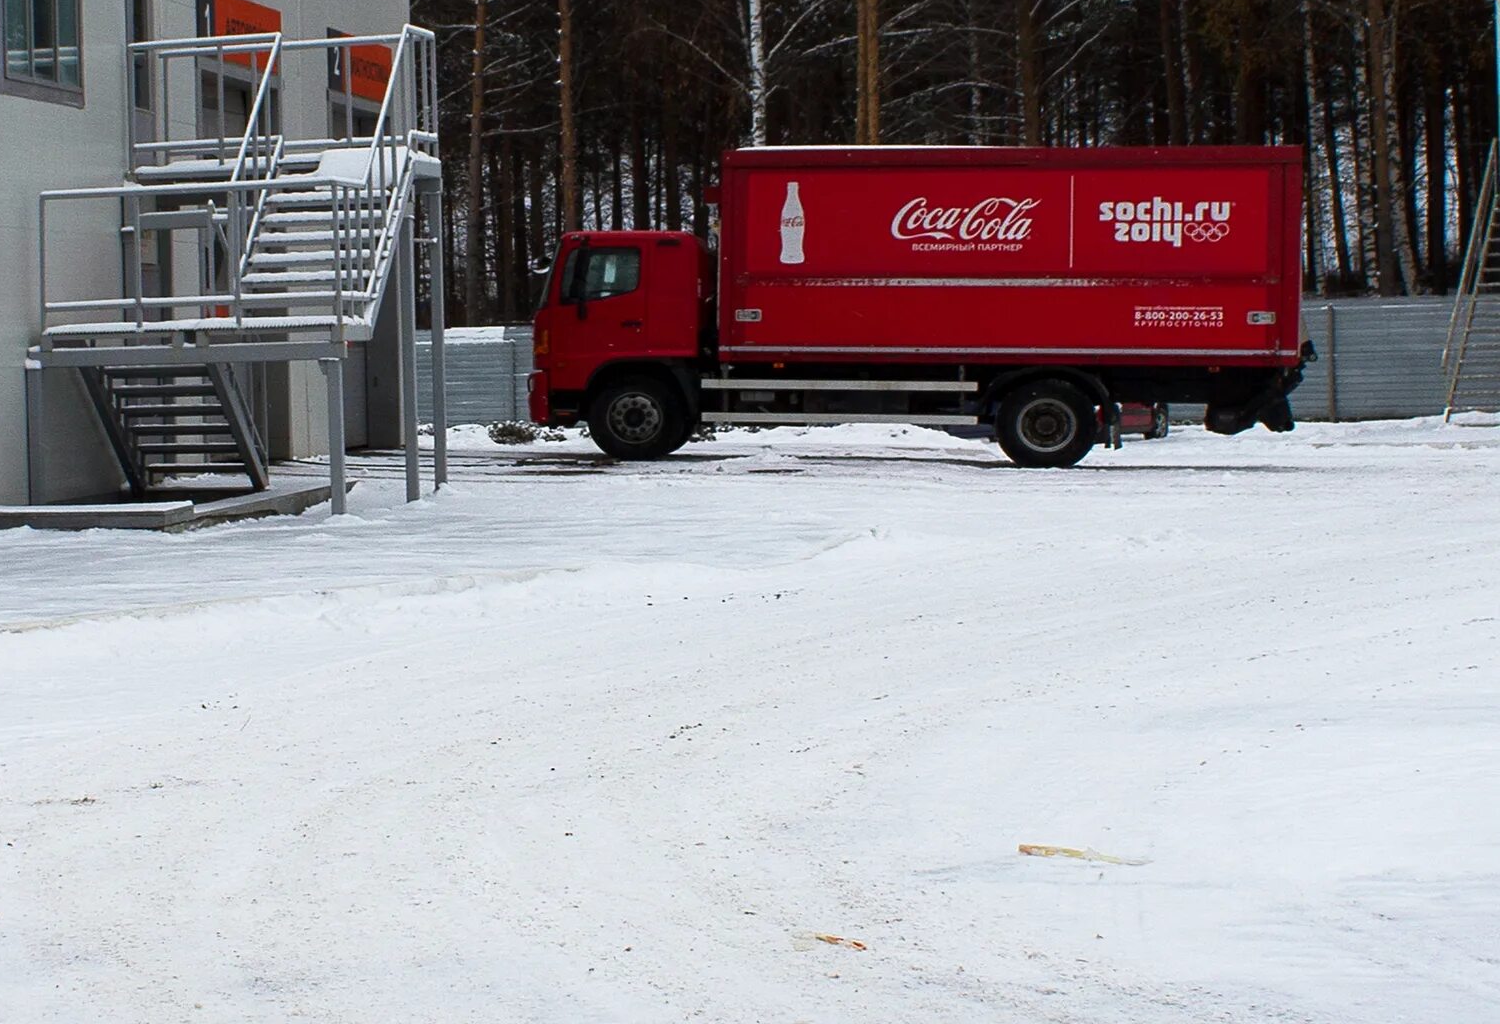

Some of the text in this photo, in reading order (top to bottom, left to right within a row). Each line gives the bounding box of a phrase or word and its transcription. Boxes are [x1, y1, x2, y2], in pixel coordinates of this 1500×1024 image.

[891, 197, 1042, 240] Coca-Cola
[1099, 197, 1231, 221] sochi.ru
[911, 242, 1023, 251] ВСЕМИРНЫЙ ПАРТНЕР
